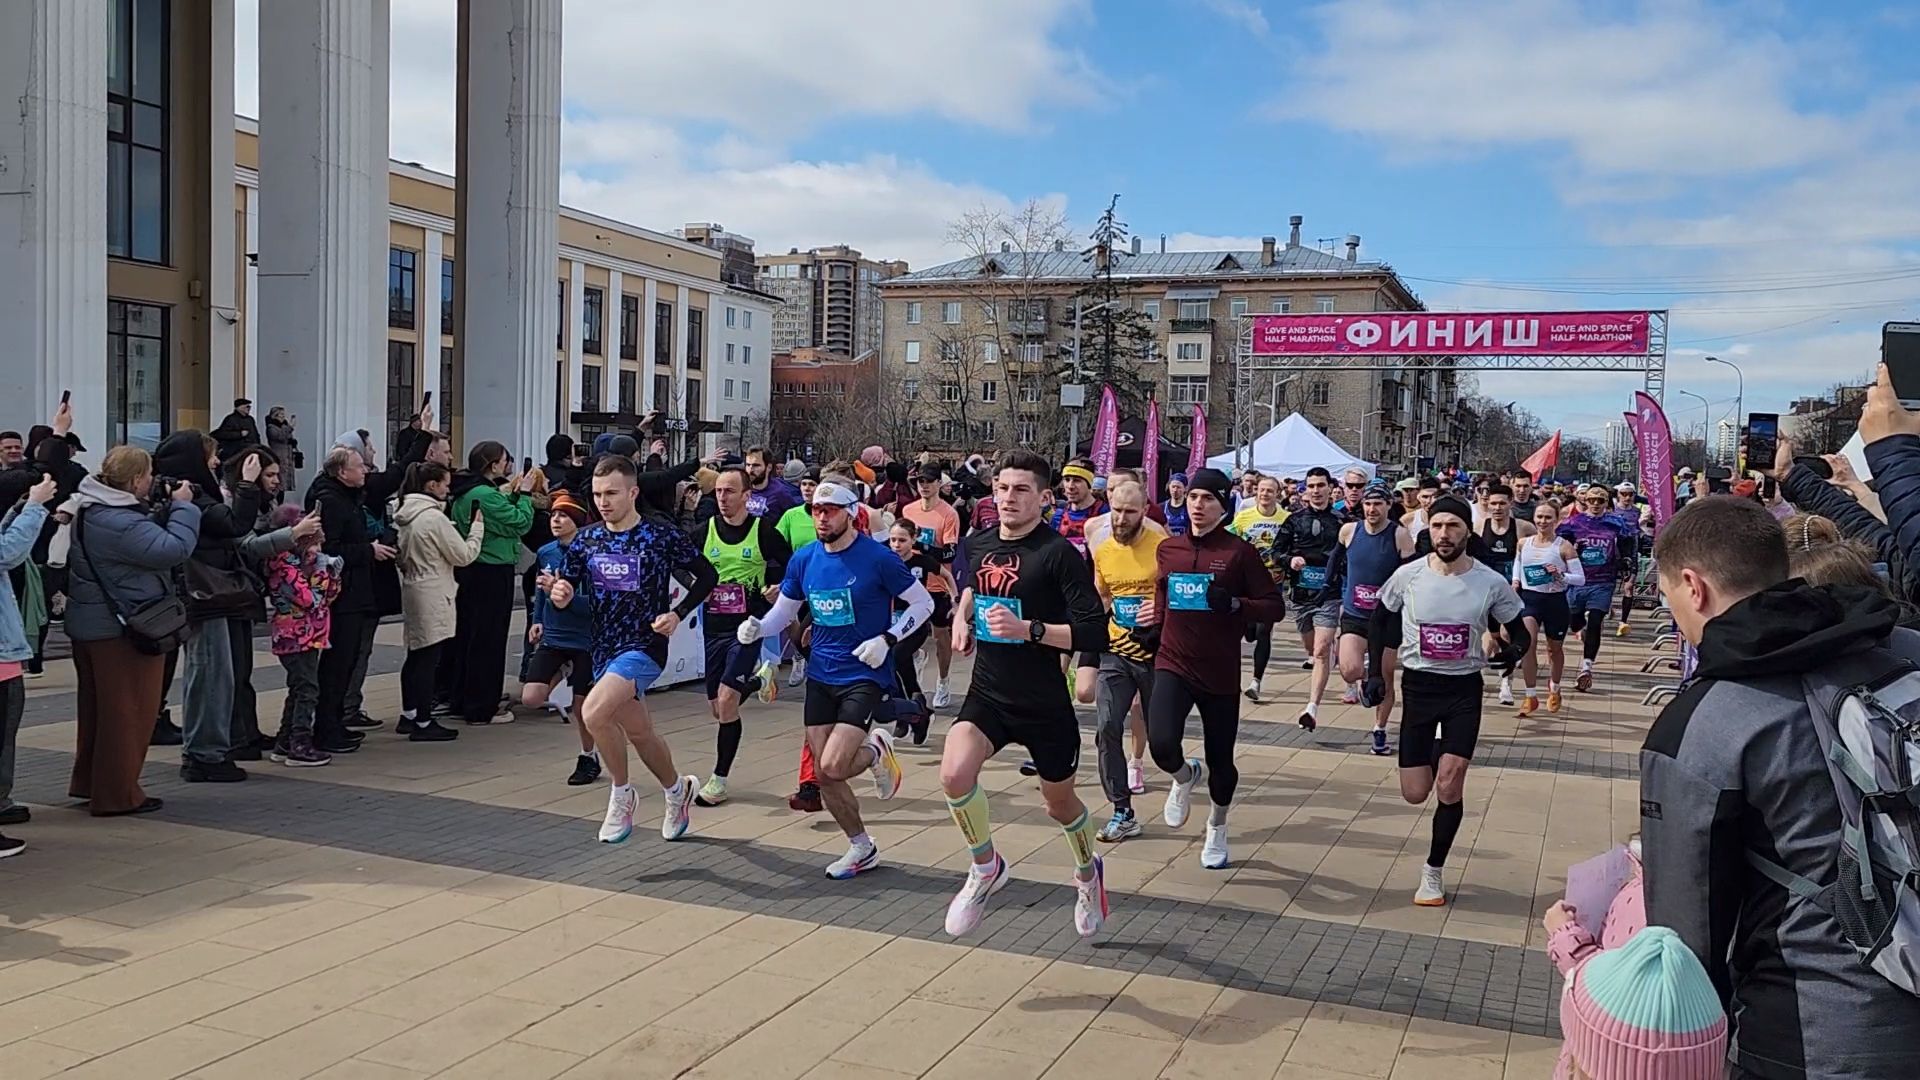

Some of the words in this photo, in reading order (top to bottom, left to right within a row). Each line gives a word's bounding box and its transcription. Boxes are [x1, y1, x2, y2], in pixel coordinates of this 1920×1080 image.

[1308, 326, 1336, 334] SPACE
[1346, 320, 1539, 347] ФИНИШ
[1551, 325, 1576, 333] LOVE
[1600, 324, 1633, 332] SPACE
[1265, 335, 1287, 343] HALF
[600, 563, 629, 575] 1263
[1175, 582, 1204, 594] 5104
[1357, 591, 1375, 599] 204
[813, 599, 844, 611] 5009
[1426, 633, 1463, 644] 2043
